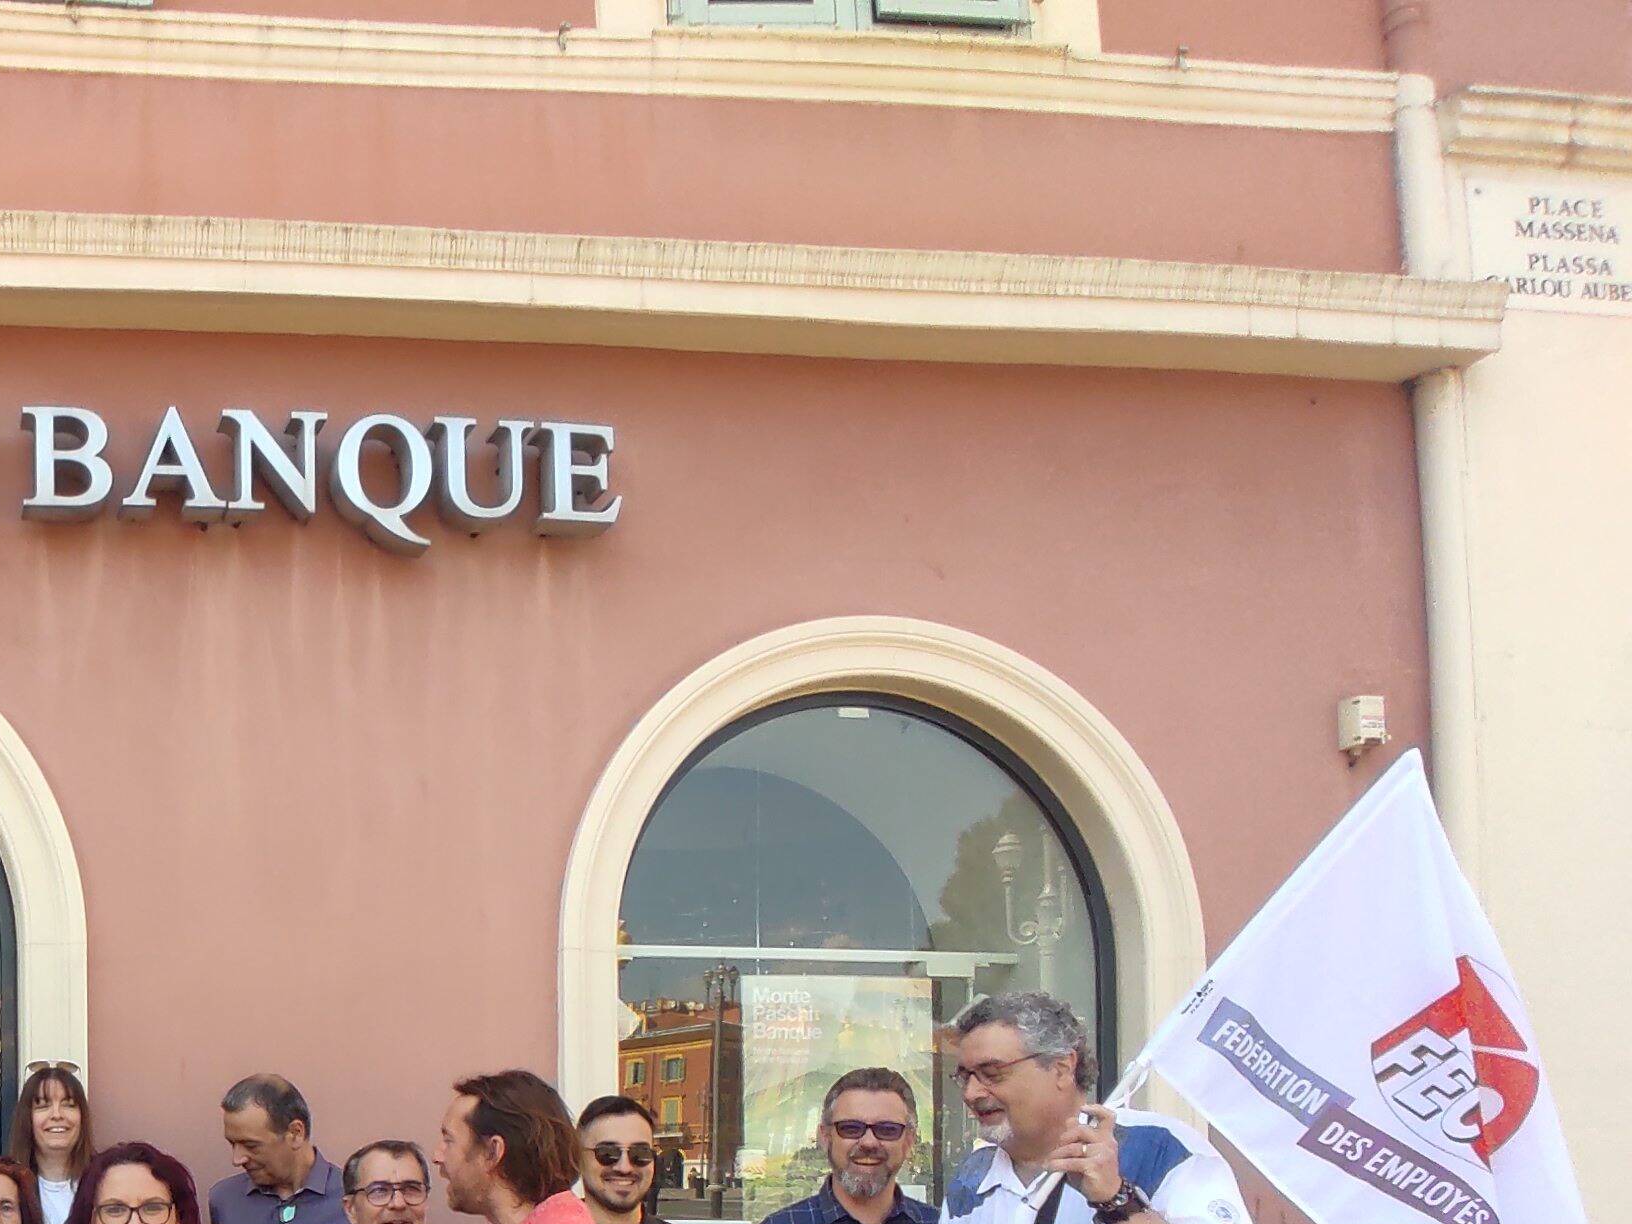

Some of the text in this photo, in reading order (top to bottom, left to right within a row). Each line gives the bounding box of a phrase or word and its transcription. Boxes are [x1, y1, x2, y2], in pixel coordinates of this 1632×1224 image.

[1528, 196, 1603, 218] PLACE
[1515, 220, 1620, 244] MASSENA
[1527, 252, 1613, 276] PLASSA
[21, 404, 623, 555] BANQUE
[752, 986, 811, 1003] Monte
[752, 1004, 821, 1021] Paschi
[752, 1022, 822, 1042] Banque
[1212, 1018, 1331, 1116] FÉDÉRATION
[1317, 1120, 1374, 1163] DES
